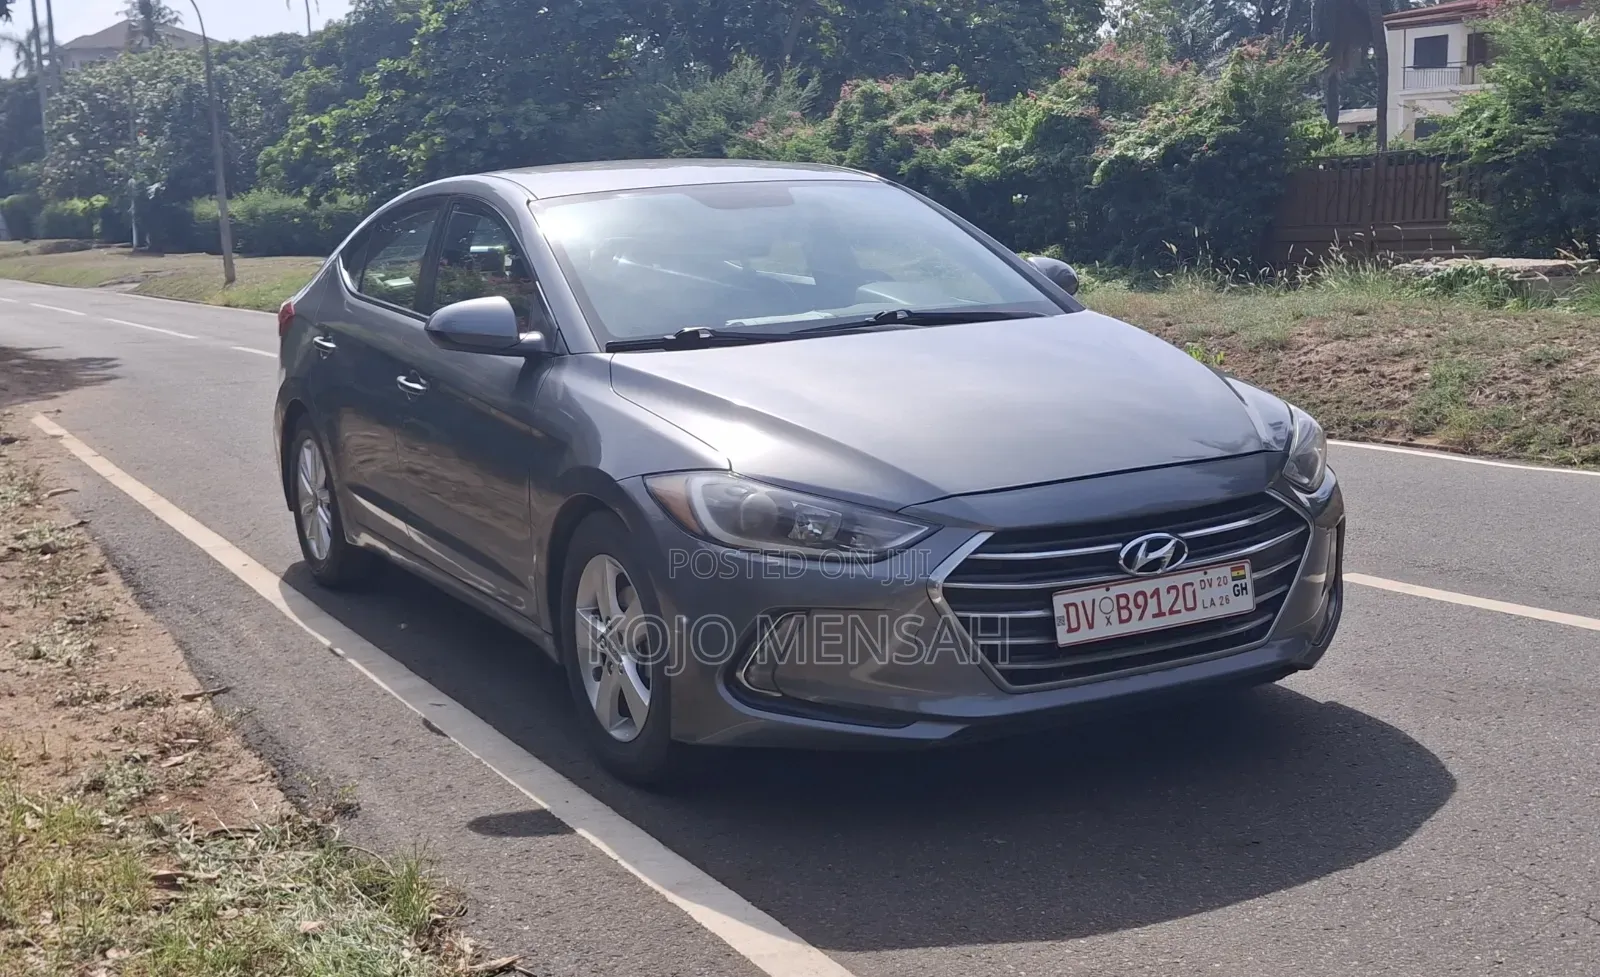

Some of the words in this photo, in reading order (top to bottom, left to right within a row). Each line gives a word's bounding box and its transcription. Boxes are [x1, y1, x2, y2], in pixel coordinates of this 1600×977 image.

[1200, 578, 1213, 590] DV
[1217, 575, 1228, 587] 20
[1232, 582, 1249, 598] GH
[1063, 598, 1096, 634] DV
[1115, 581, 1198, 625] B9120
[1202, 597, 1216, 609] LA
[1105, 615, 1113, 627] X
